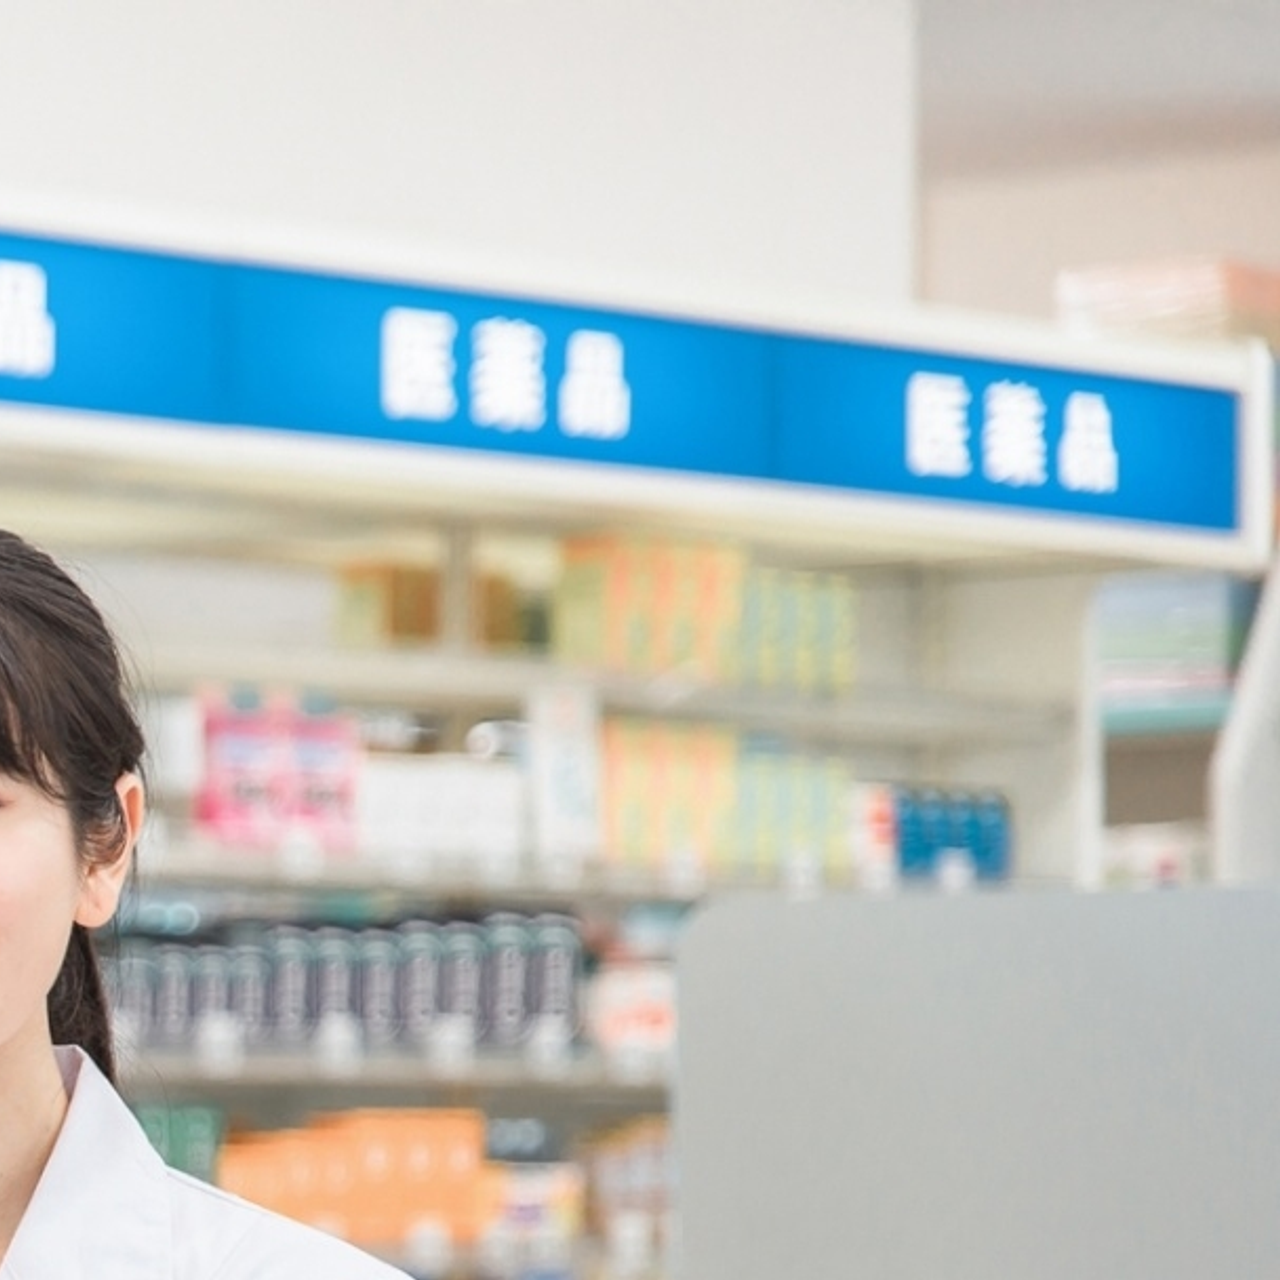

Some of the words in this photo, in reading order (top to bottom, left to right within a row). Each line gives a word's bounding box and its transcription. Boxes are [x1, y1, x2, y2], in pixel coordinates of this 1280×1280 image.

[381, 308, 630, 438] 医薬品
[906, 373, 1117, 492] 医薬品
